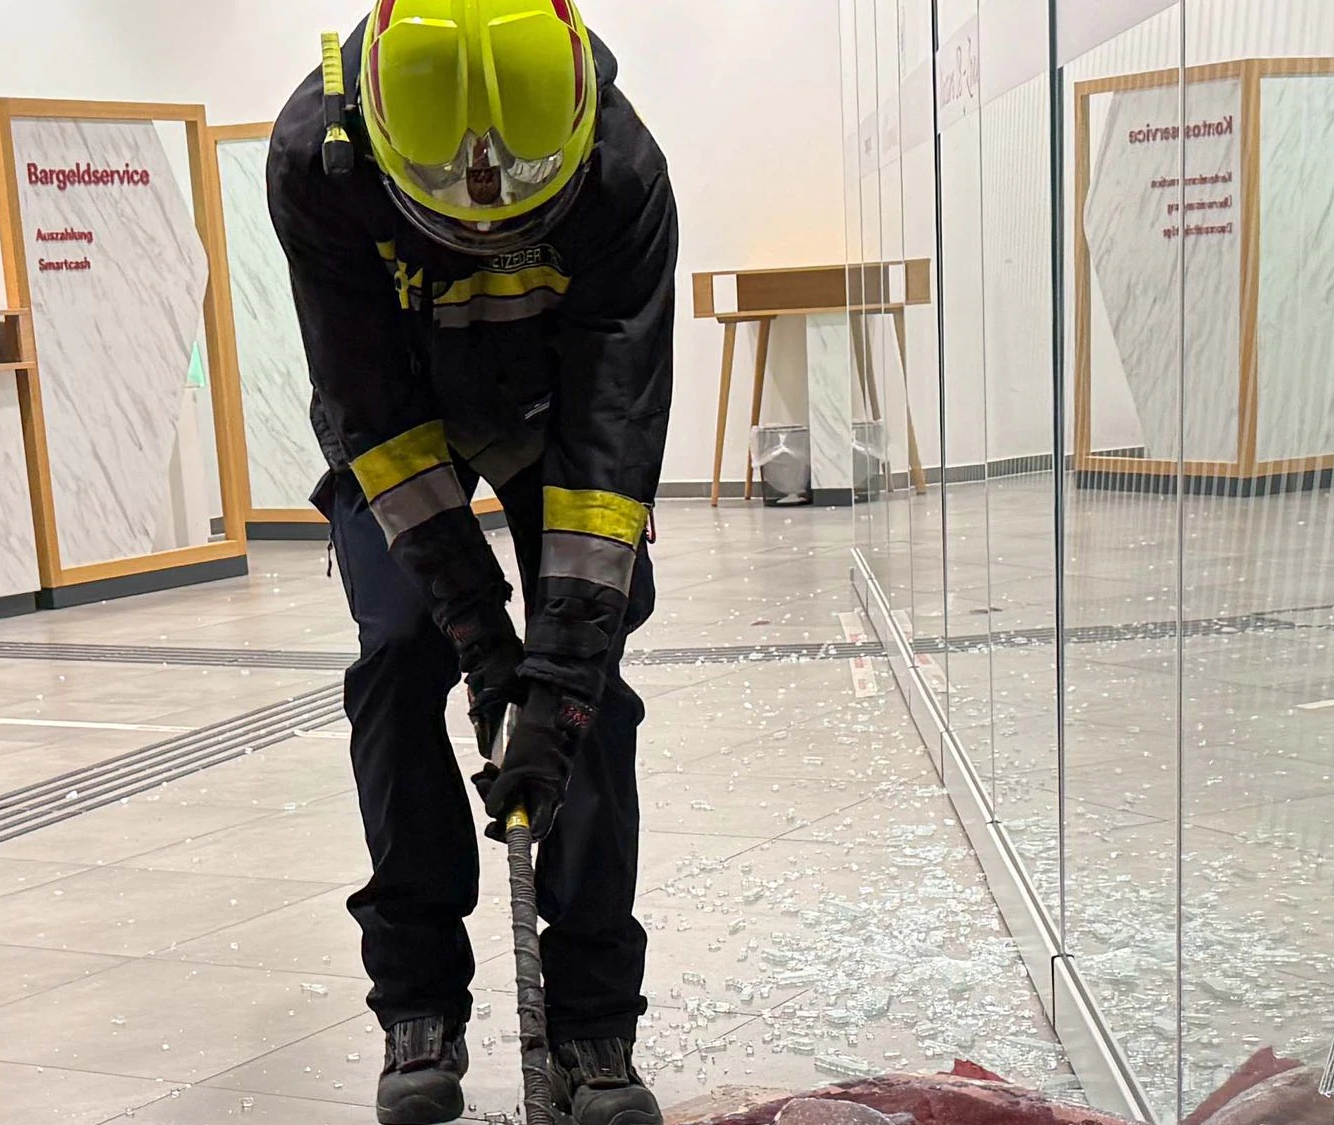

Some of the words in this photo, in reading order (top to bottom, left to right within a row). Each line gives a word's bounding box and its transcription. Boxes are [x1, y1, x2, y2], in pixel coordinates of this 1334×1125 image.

[26, 162, 150, 191] Bargeldservice
[35, 227, 94, 244] Auszahlung
[38, 257, 91, 272] Smartcash
